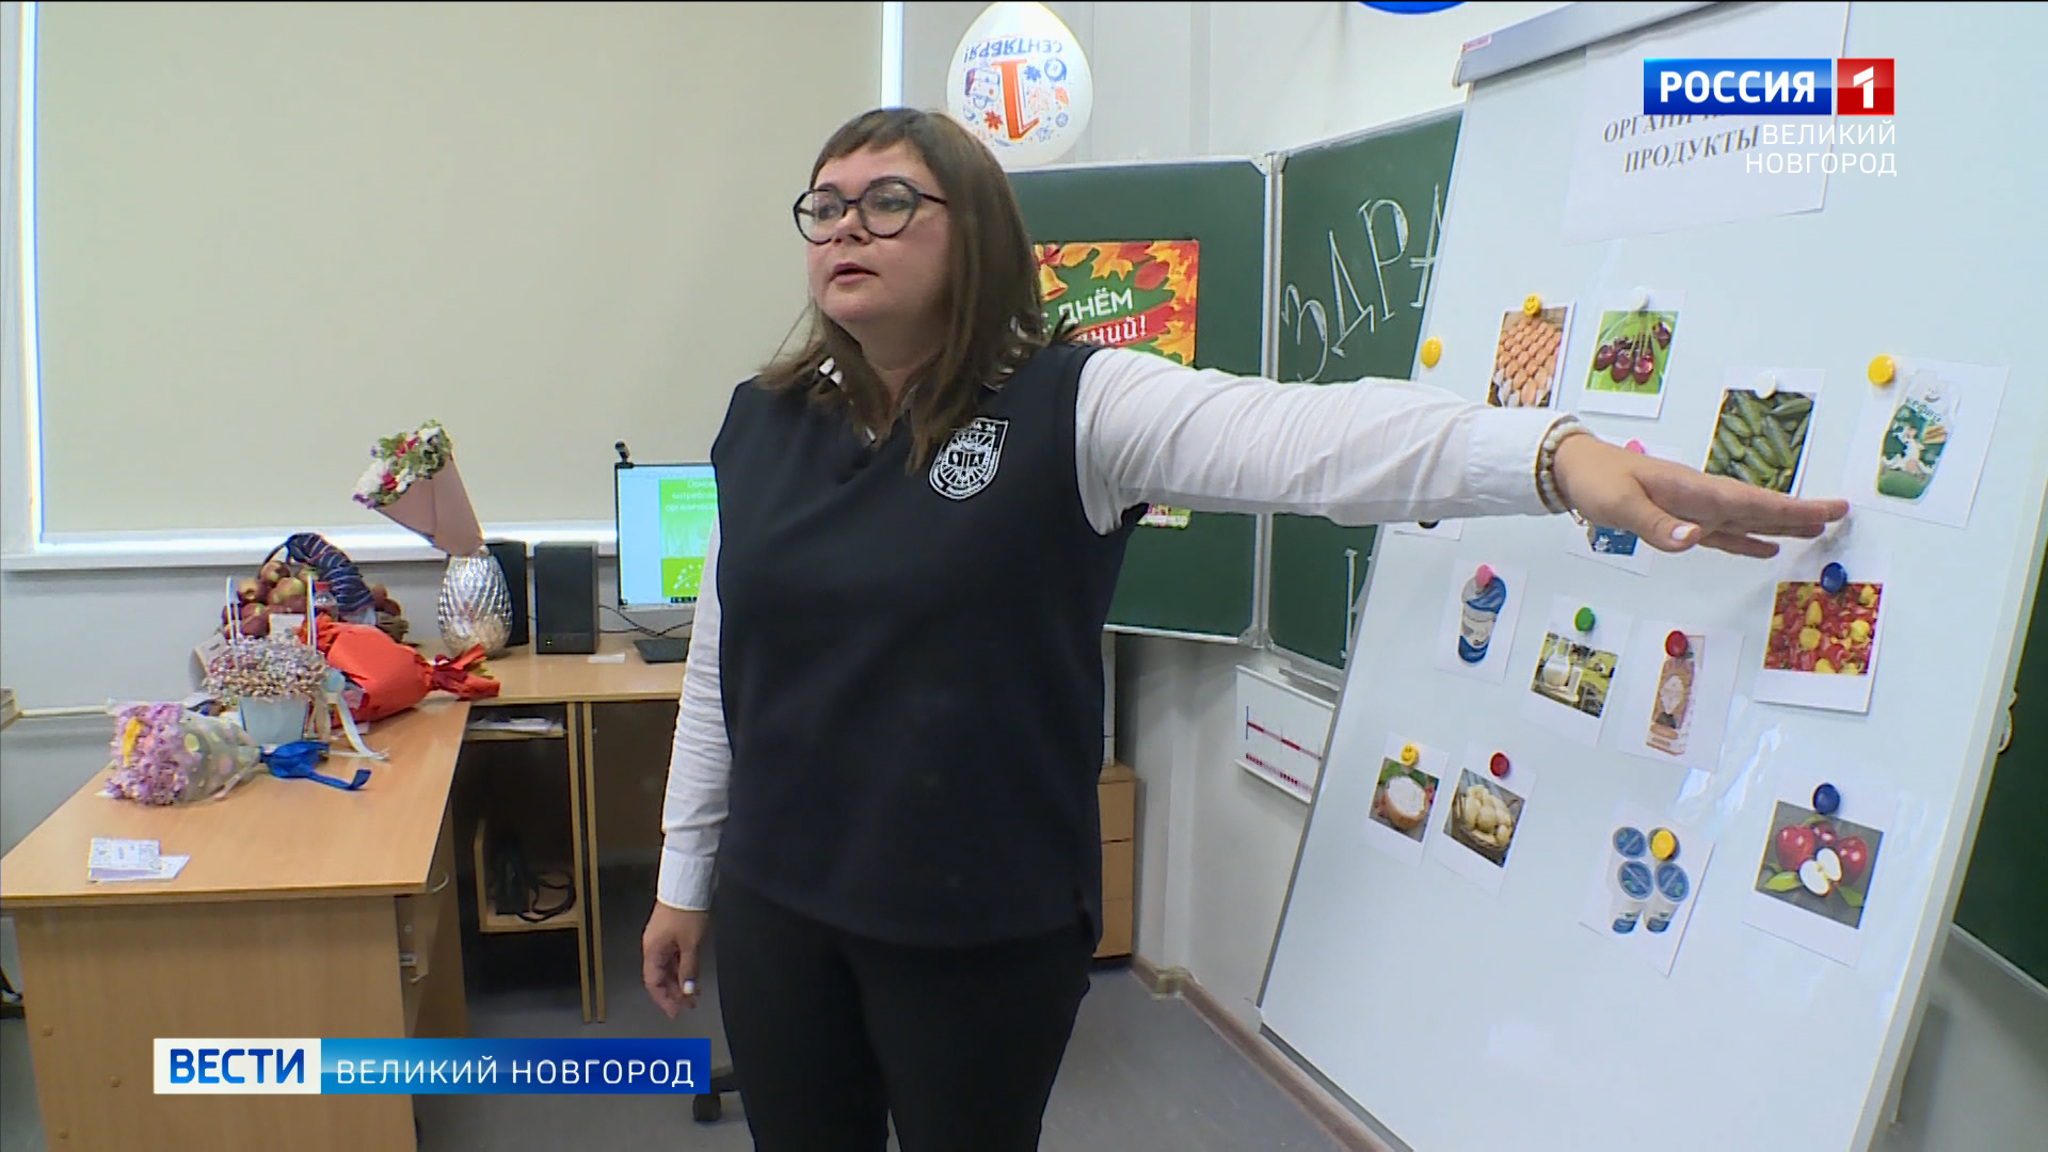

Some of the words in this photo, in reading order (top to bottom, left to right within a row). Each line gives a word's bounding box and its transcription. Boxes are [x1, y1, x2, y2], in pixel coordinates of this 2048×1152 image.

[963, 38, 1063, 63] СЕНТЯБРЯ!
[1623, 125, 1759, 173] ПРОДУКТЫ
[1058, 287, 1133, 325] ДНЁМ
